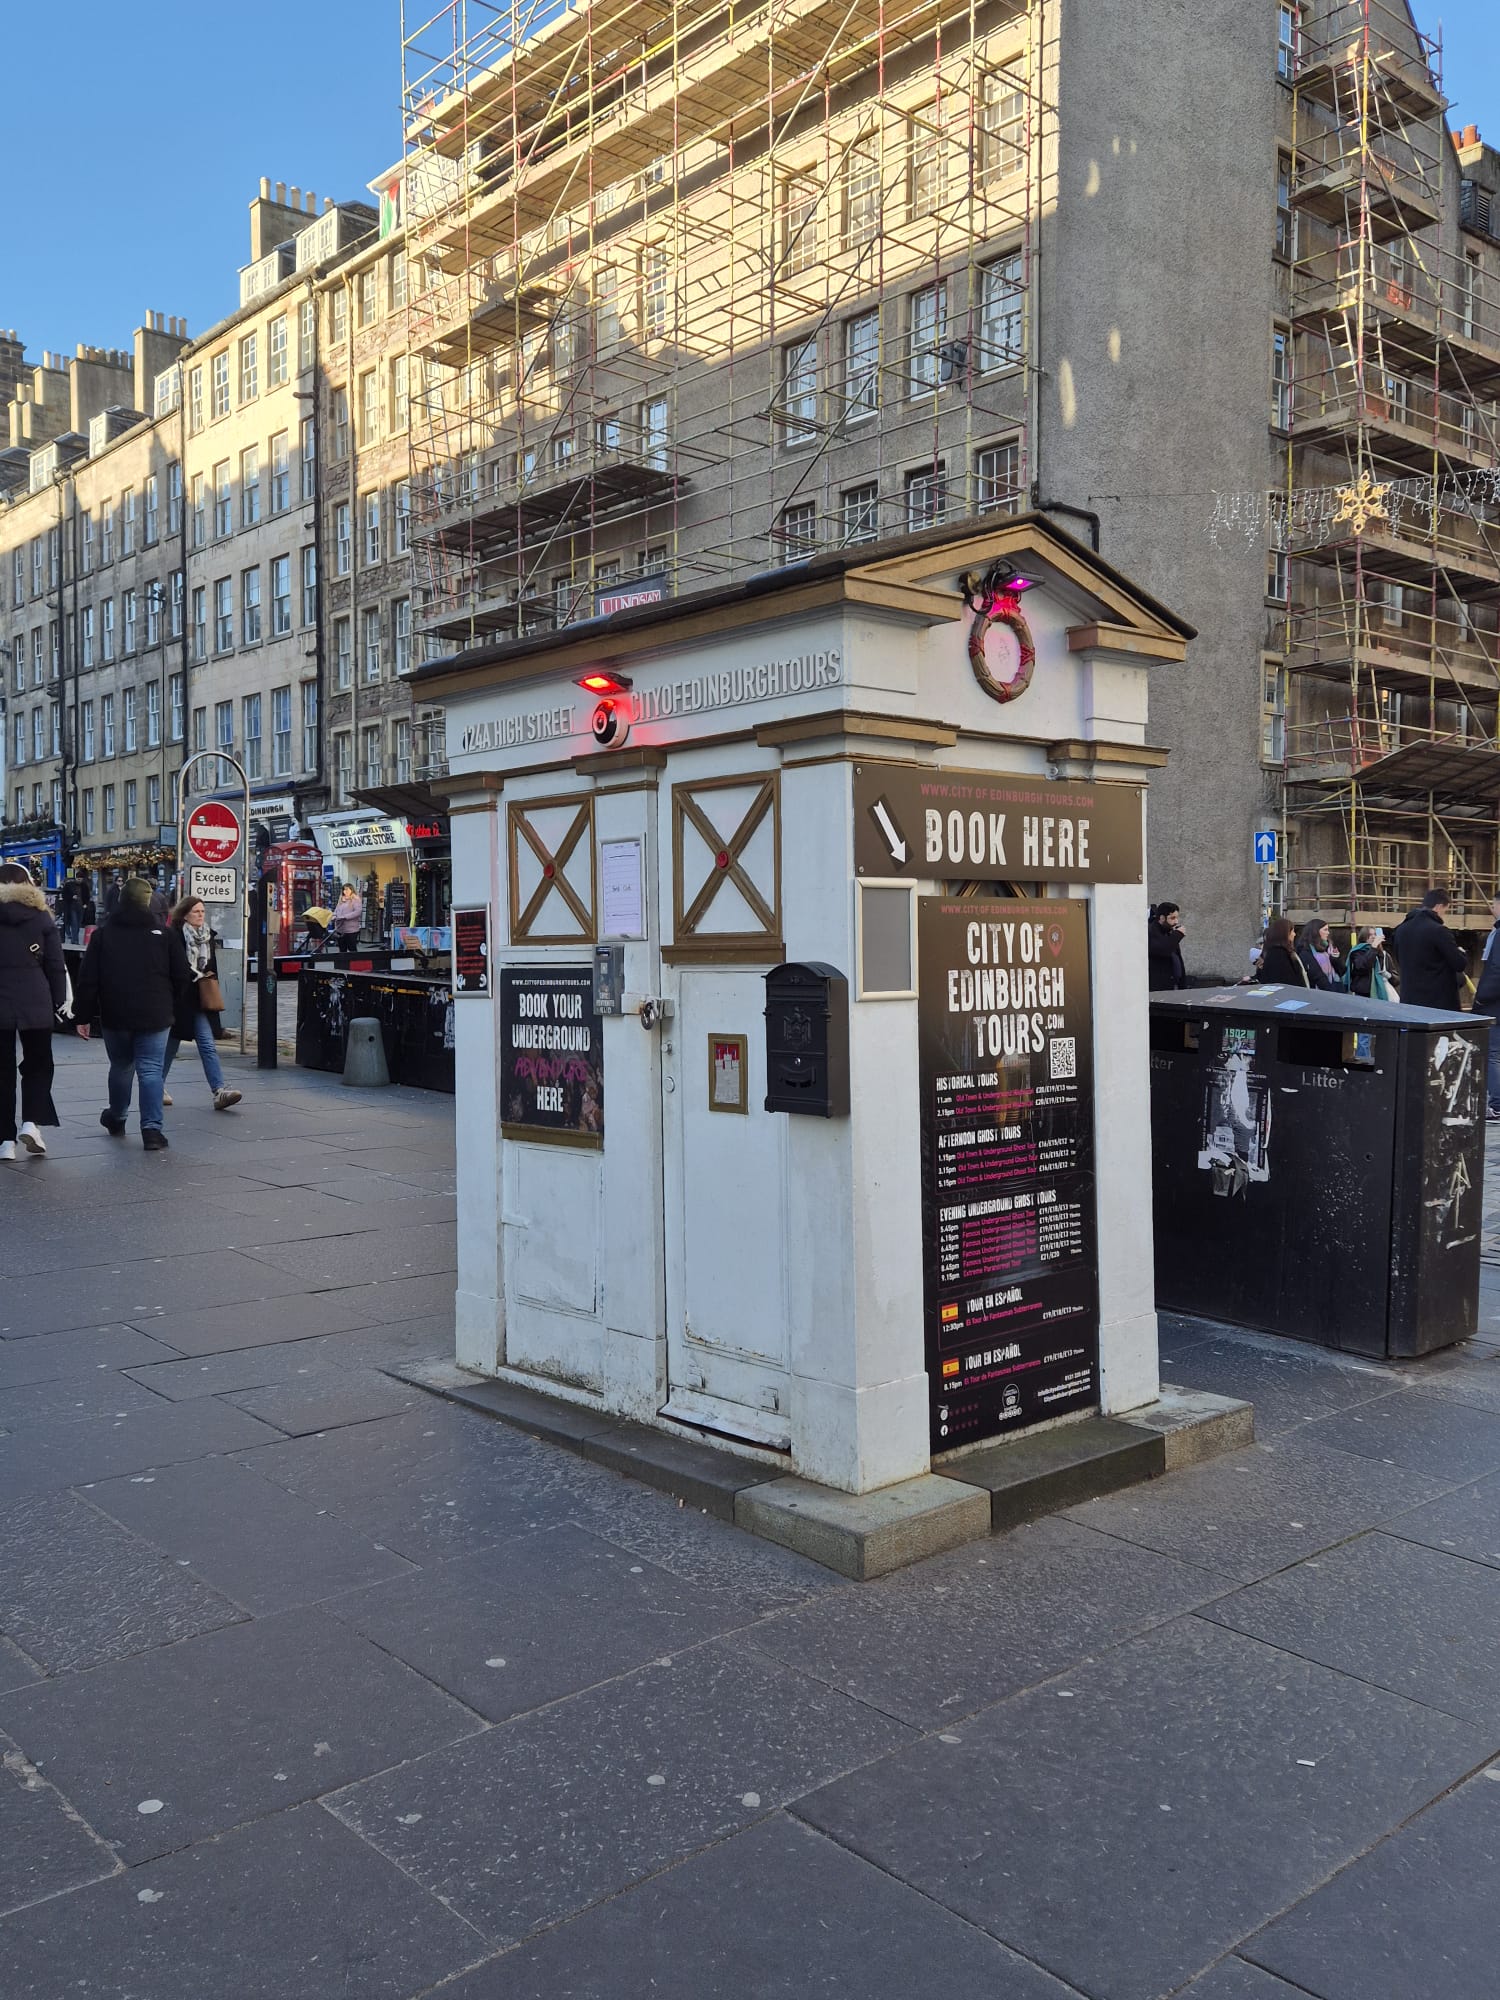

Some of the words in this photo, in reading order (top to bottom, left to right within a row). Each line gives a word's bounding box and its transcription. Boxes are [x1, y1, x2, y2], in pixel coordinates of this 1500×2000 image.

[630, 648, 842, 722] CITYOFEDINBURGHTOURS
[494, 715, 526, 748] HIGH
[527, 705, 576, 740] STREET
[975, 790, 988, 800] OF
[990, 790, 1043, 804] EDINBURGH
[1044, 795, 1094, 808] TOURS.COM
[332, 836, 373, 849] CLEARANCE
[374, 833, 396, 844] STORE
[926, 808, 1007, 866] BOOK
[1023, 816, 1090, 868] HERE
[195, 872, 232, 884] Except
[196, 886, 230, 896] cycles
[967, 921, 1015, 965] CITY
[1020, 922, 1044, 963] OF
[948, 966, 1065, 1012] EDINBURGH
[518, 993, 549, 1019] BOOK
[552, 994, 583, 1020] YOUR
[511, 1024, 592, 1052] UNDERGROUND
[972, 1012, 1045, 1058] TOURS
[1152, 1056, 1175, 1071] tter
[936, 1075, 976, 1092] HISTORICAL
[977, 1072, 999, 1087] TOURS
[1302, 1072, 1346, 1090] Litter
[536, 1085, 564, 1113] HERE
[938, 1130, 976, 1148] AFTERNOON
[977, 1128, 999, 1144] GHOST
[1000, 1124, 1022, 1140] TOURS
[940, 1204, 967, 1222] EVENING
[968, 1196, 1012, 1217] UNDERGROUND
[1014, 1193, 1034, 1208] GHOST
[1036, 1189, 1057, 1205] TOURS
[966, 1296, 984, 1314] TOUR
[984, 1294, 994, 1308] EN
[994, 1286, 1023, 1306] ESPAÑOL
[942, 1322, 964, 1332] 12:30pm
[964, 1353, 982, 1371] TOUR
[983, 1352, 992, 1366] EN
[992, 1343, 1022, 1362] ESPAÑOL
